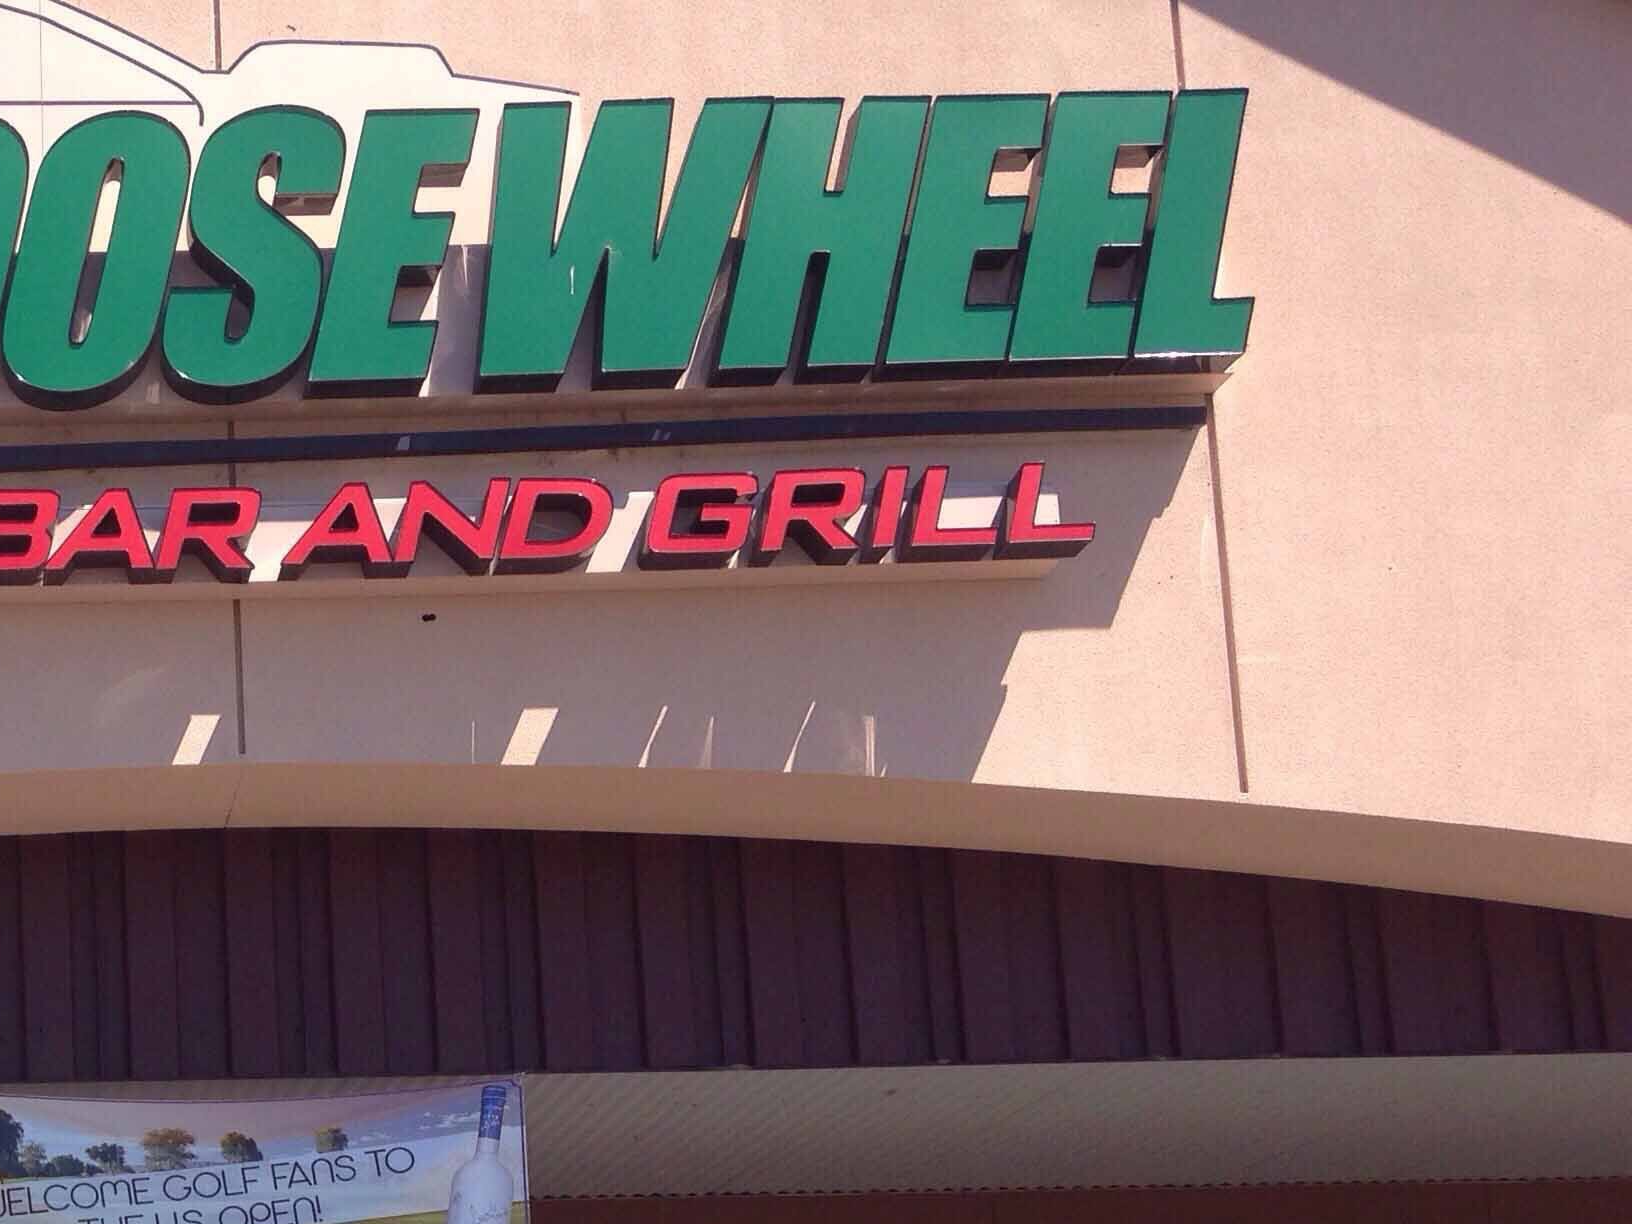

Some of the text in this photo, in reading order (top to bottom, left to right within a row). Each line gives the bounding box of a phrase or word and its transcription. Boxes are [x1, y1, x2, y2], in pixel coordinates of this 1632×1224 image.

[279, 475, 614, 580] AND
[638, 461, 1096, 572] GRILL
[163, 1165, 260, 1202] GOLF
[271, 1154, 357, 1190] FANS
[365, 1146, 416, 1177] TO
